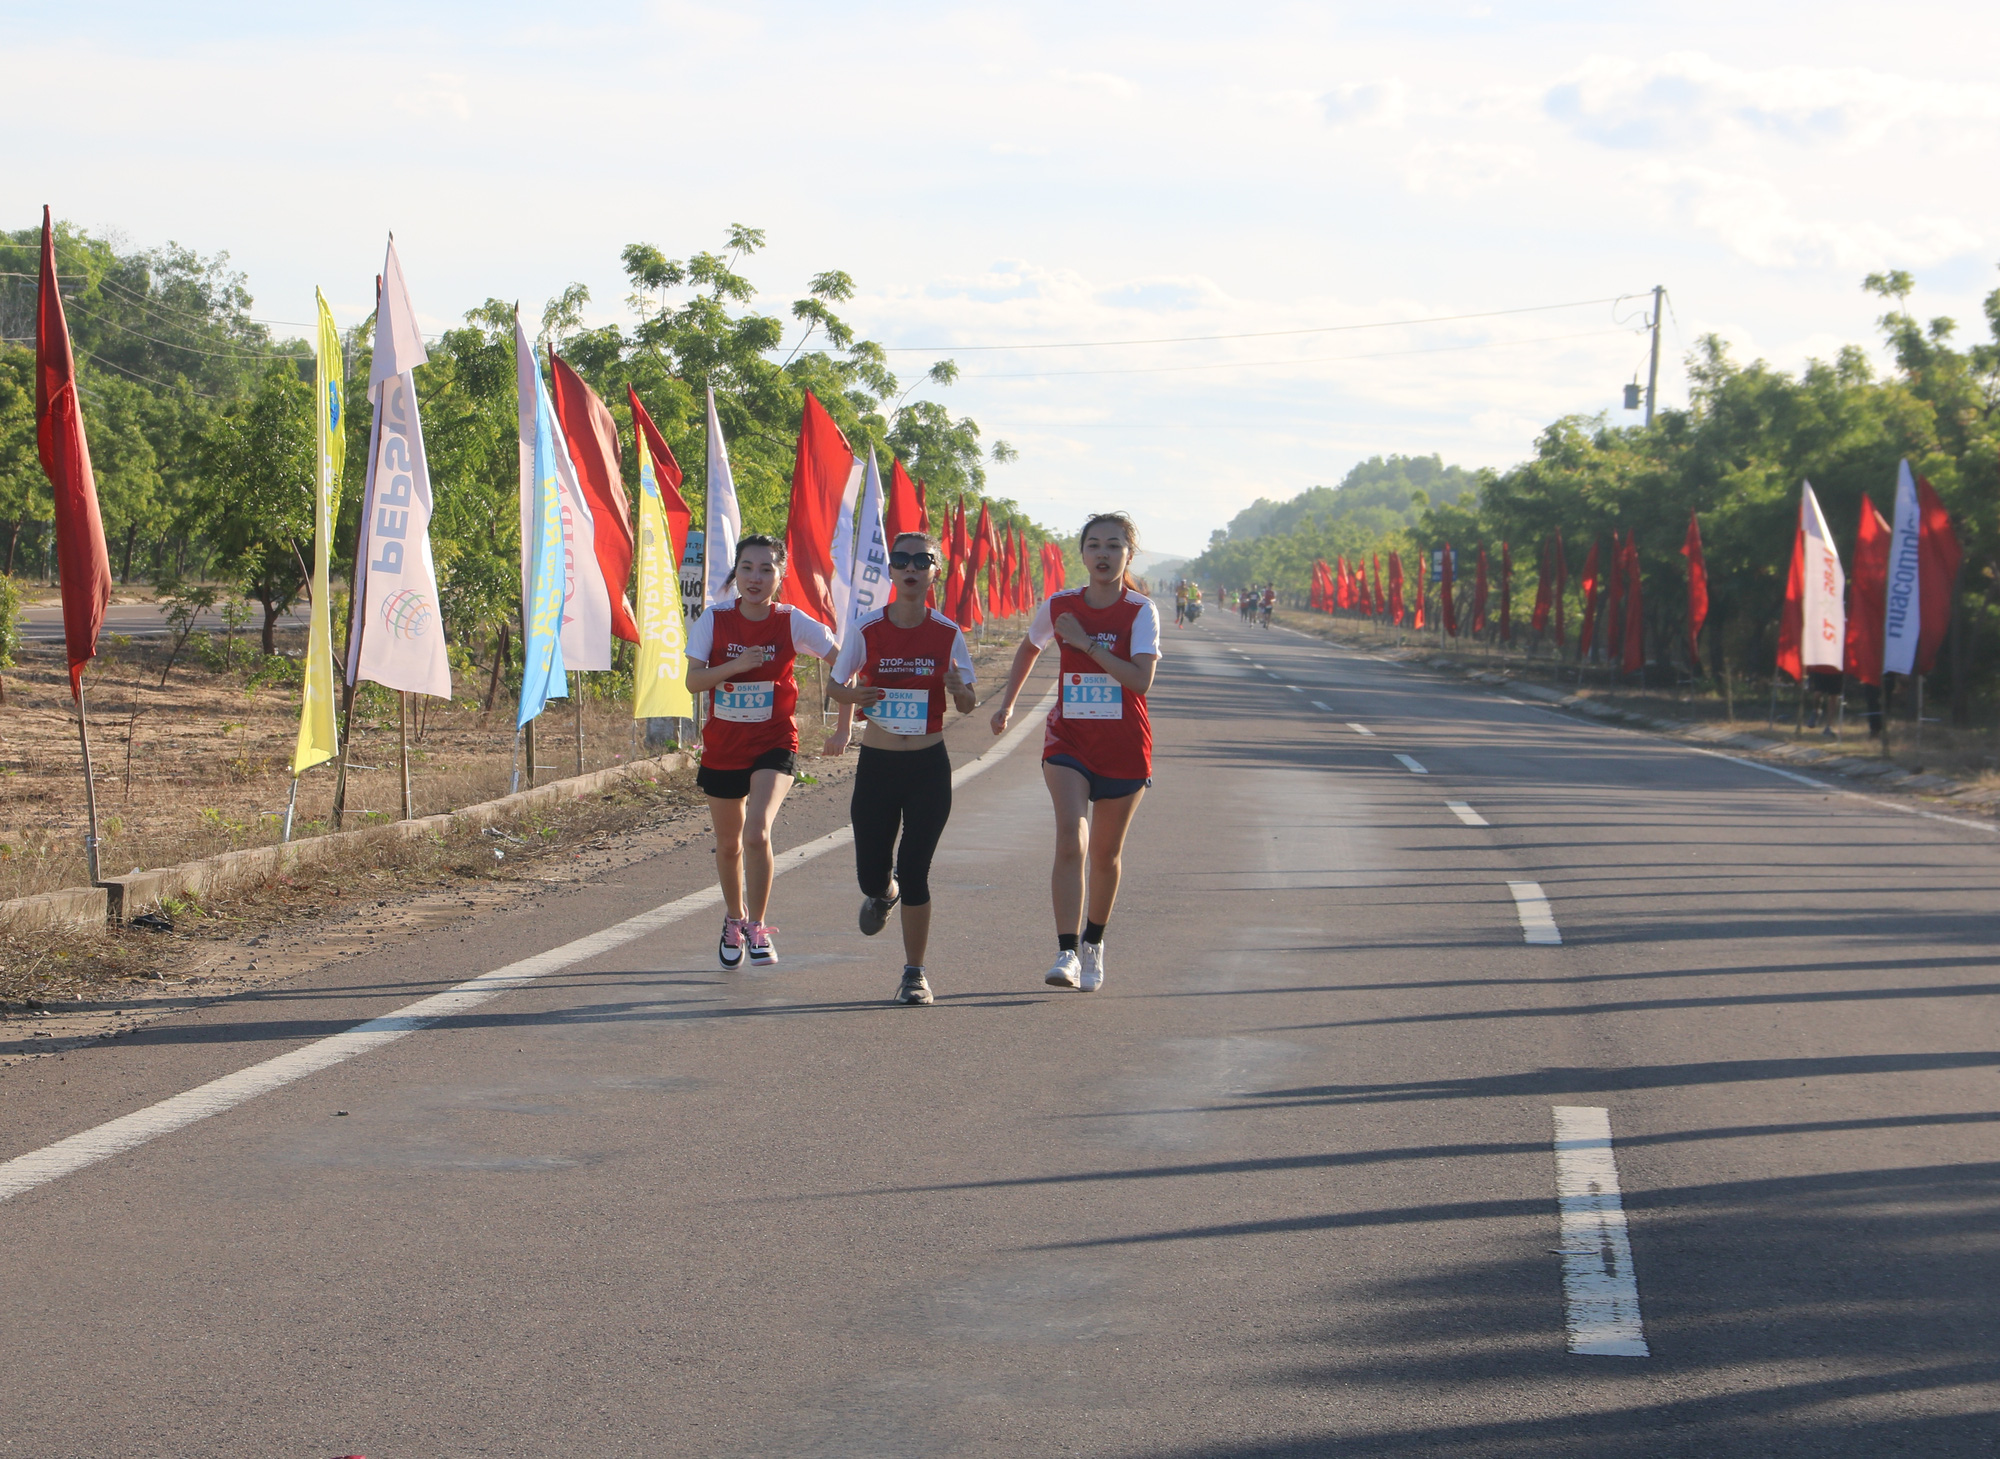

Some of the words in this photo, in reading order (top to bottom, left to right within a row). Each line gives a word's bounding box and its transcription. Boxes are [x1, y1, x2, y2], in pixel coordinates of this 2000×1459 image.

[1097, 633, 1117, 642] RUN
[879, 658, 903, 666] STOP
[915, 658, 935, 667] RUN
[915, 667, 935, 676] BTV
[722, 693, 766, 707] 5129
[1070, 687, 1113, 702] 5125
[872, 702, 919, 718] 5128
